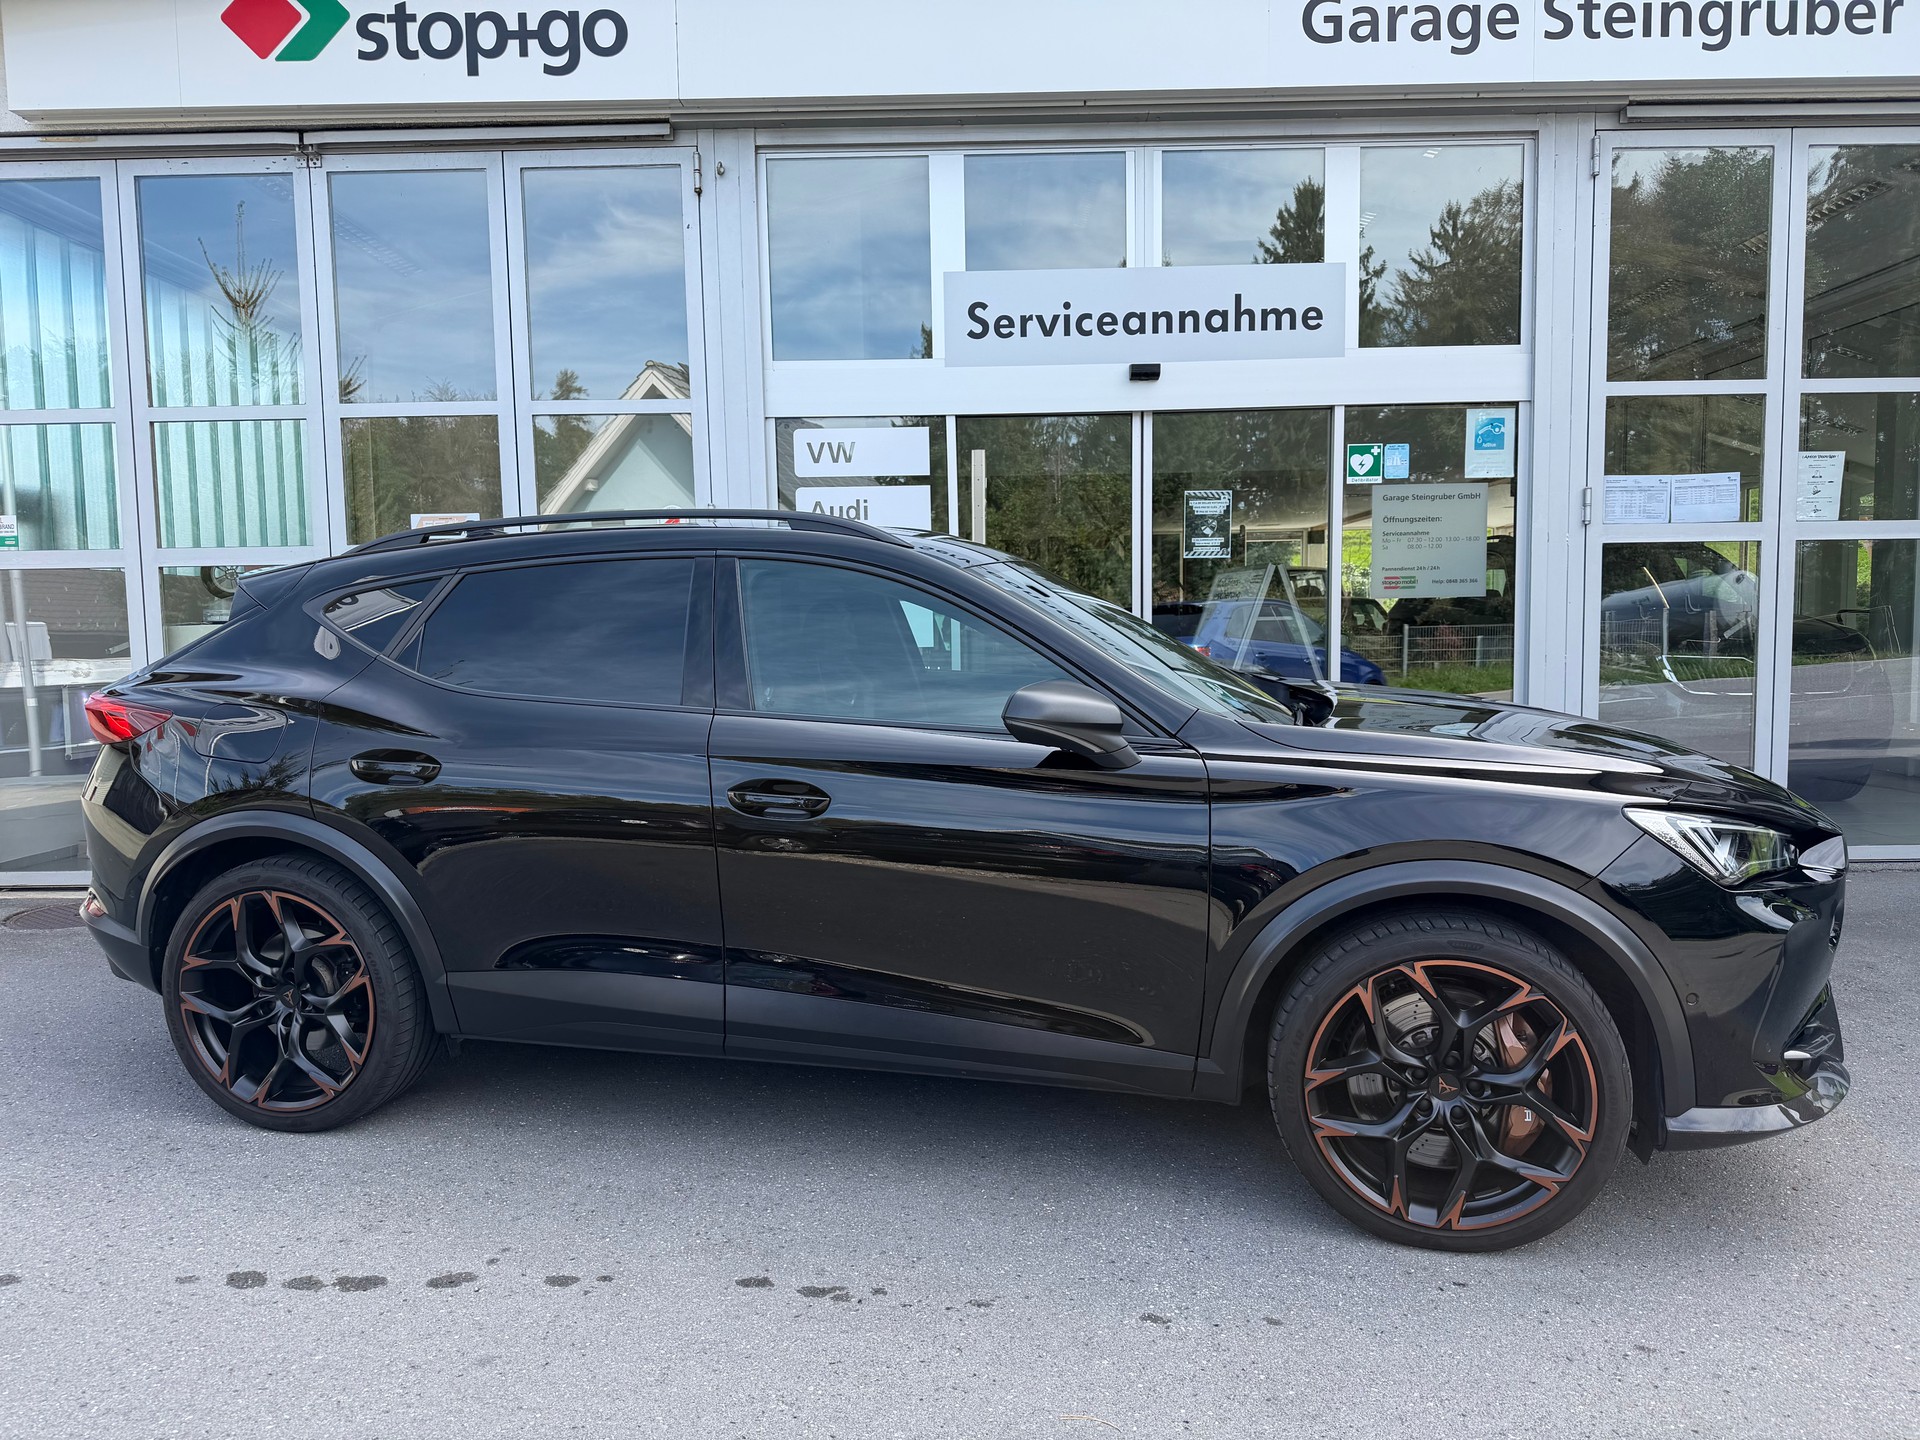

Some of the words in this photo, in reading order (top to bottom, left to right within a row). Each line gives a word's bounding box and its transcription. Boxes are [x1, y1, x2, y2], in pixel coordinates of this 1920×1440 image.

[356, 1, 628, 76] stop+go
[1301, 0, 1520, 55] Garage
[1543, 0, 1904, 51] Steingruber
[966, 293, 1324, 340] Serviceannahme
[806, 441, 856, 464] VW
[1382, 494, 1410, 502] Garage
[1411, 493, 1456, 502] Steingruber
[1457, 492, 1481, 500] GmbH
[811, 499, 869, 521] Audi
[1382, 516, 1443, 524] Öffnungszeiten:
